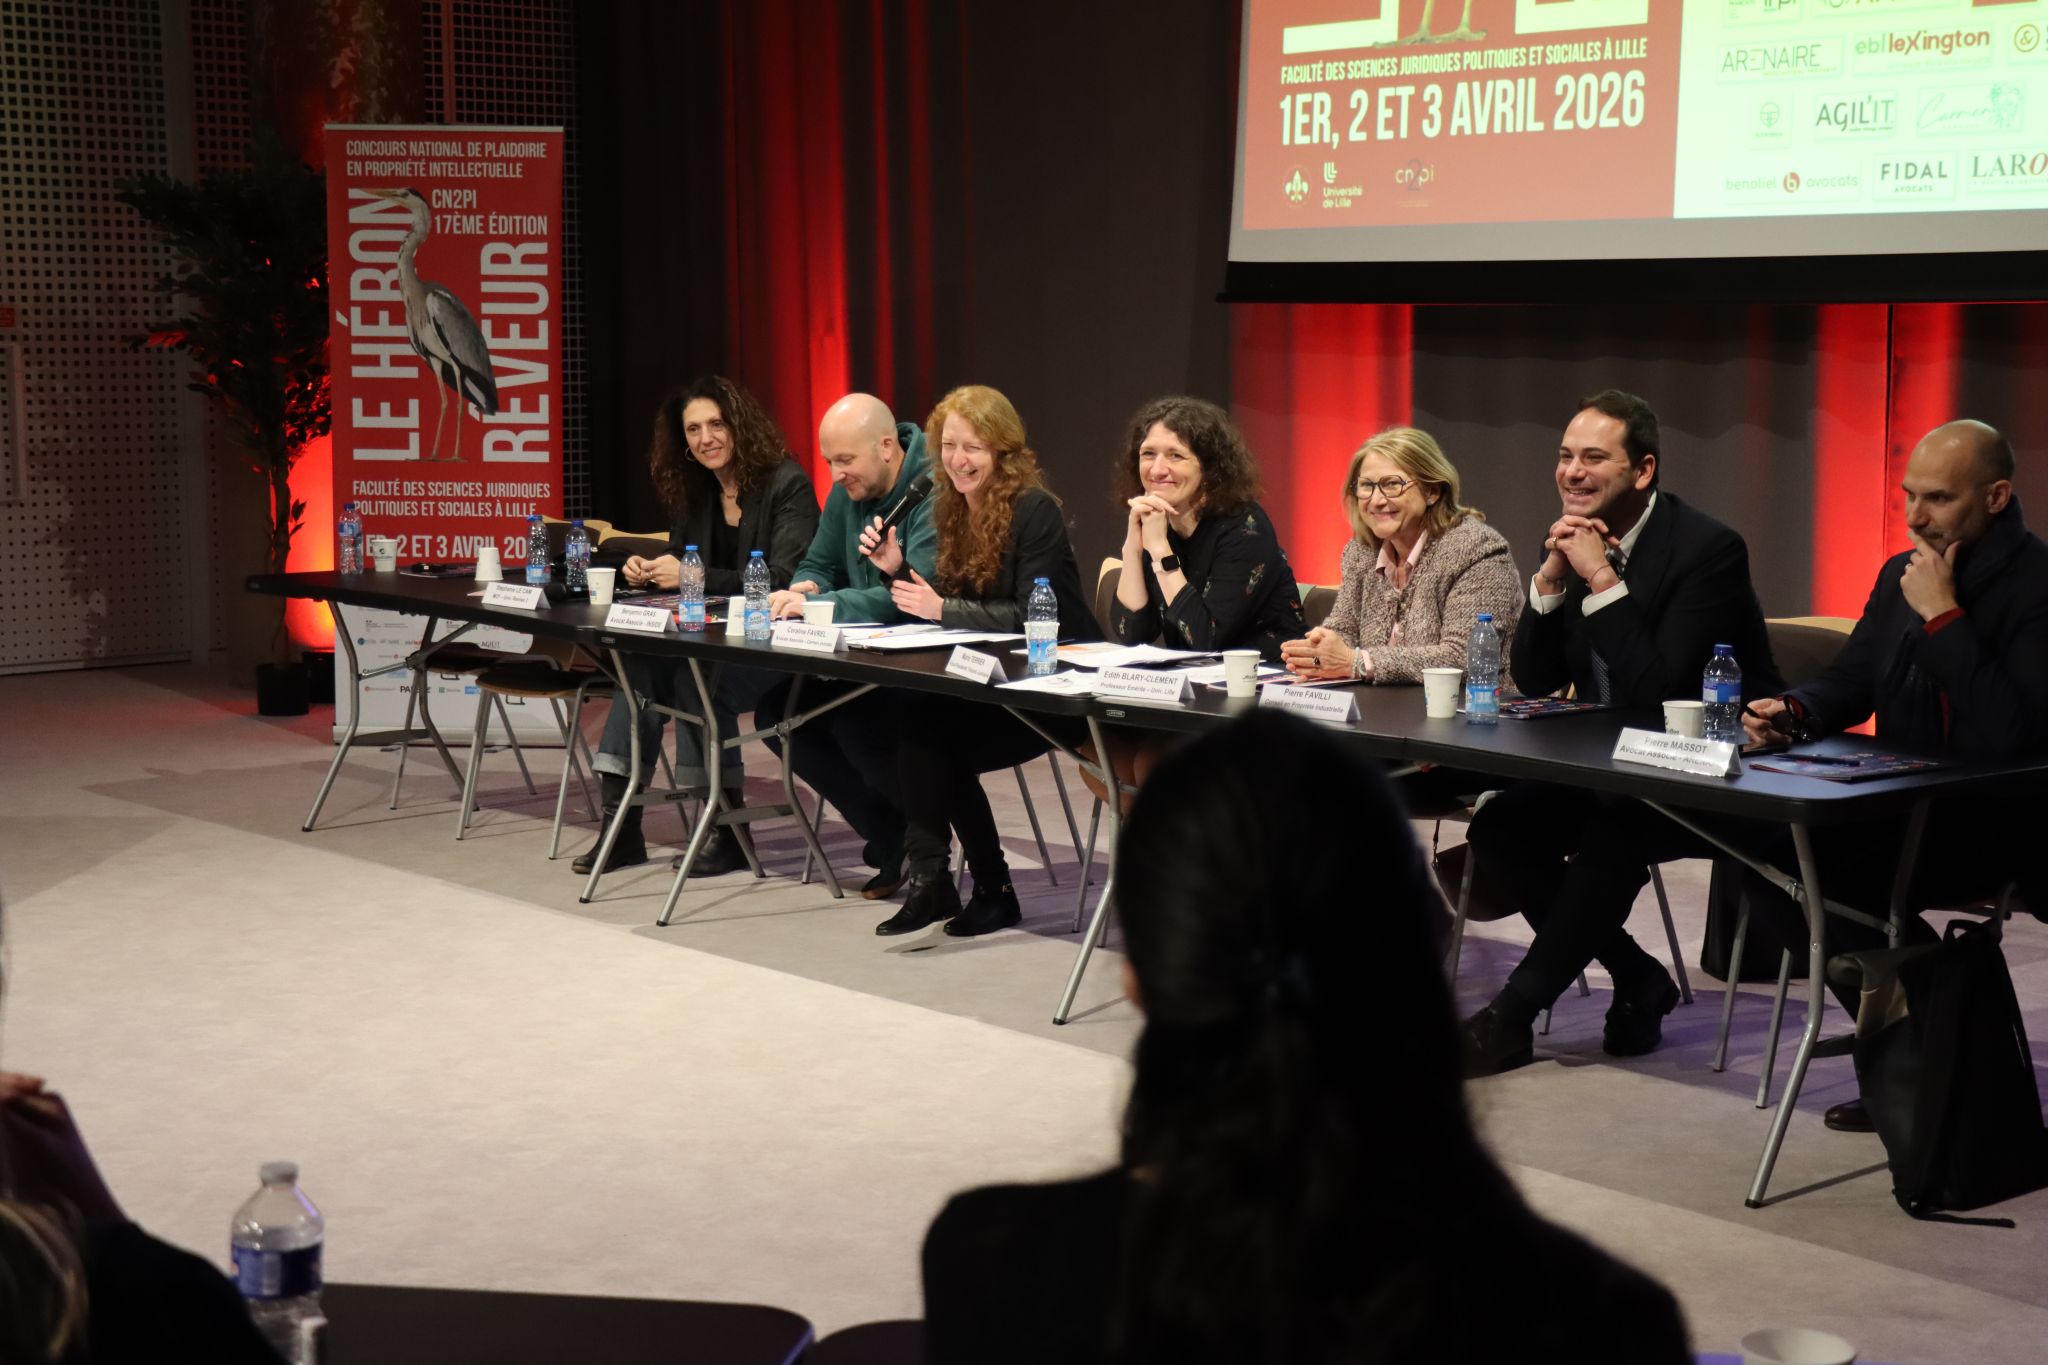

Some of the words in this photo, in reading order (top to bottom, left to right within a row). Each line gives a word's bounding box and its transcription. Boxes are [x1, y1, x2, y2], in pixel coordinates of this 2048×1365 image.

[1281, 59, 1324, 86] FACULTÉ
[1326, 61, 1346, 81] DES
[1347, 56, 1398, 79] SCIENCES
[1399, 51, 1461, 76] JURIDIQUES
[1462, 47, 1527, 72] POLITIQUES
[1529, 48, 1544, 67] ET
[1546, 40, 1600, 65] SOCIALES
[1603, 36, 1613, 60] À
[1614, 37, 1648, 60] LILLE
[1280, 87, 1340, 150] 1ER,
[1349, 88, 1368, 143] 2
[1376, 85, 1416, 141] ET
[1422, 83, 1442, 139] 3
[1450, 77, 1544, 137] AVRIL
[1553, 69, 1646, 131] 2026
[1816, 94, 1894, 132] AGIL'IT
[346, 140, 406, 156] CONCOURS
[410, 141, 465, 157] NATIONAL
[467, 142, 482, 157] DE
[484, 142, 547, 158] PLAIDOIRIE
[347, 161, 362, 176] EN
[365, 158, 426, 177] PROPRIÉTÉ
[429, 162, 524, 178] INTELLECTUELLE
[1881, 161, 1948, 181] FIDAL
[1806, 175, 1858, 188] avocats
[431, 188, 477, 209] CN2PI
[1323, 186, 1363, 198] Université
[1323, 198, 1334, 208] de
[1335, 198, 1352, 208] Lille
[434, 212, 486, 235] 17ÈME
[488, 212, 548, 236] ÉDITION
[352, 397, 420, 461] LE
[353, 478, 400, 496] FACULTÉ
[403, 482, 425, 496] DES
[428, 482, 482, 497] SCIENCES
[486, 482, 551, 498] JURIDIQUES
[354, 500, 418, 516] POLITIQUES
[422, 502, 436, 516] ET
[438, 502, 492, 517] SOCIALES
[495, 499, 503, 517] À
[506, 502, 537, 518] LILLE
[412, 535, 433, 558] ET
[436, 535, 448, 558] 3
[1104, 671, 1120, 679] Edith
[1122, 672, 1178, 685] BLARY-CLEMENT
[1284, 688, 1304, 698] Pierre
[1304, 690, 1332, 701] FAVILLI
[1644, 736, 1668, 748] Pierre
[1670, 740, 1708, 754] MASSOT
